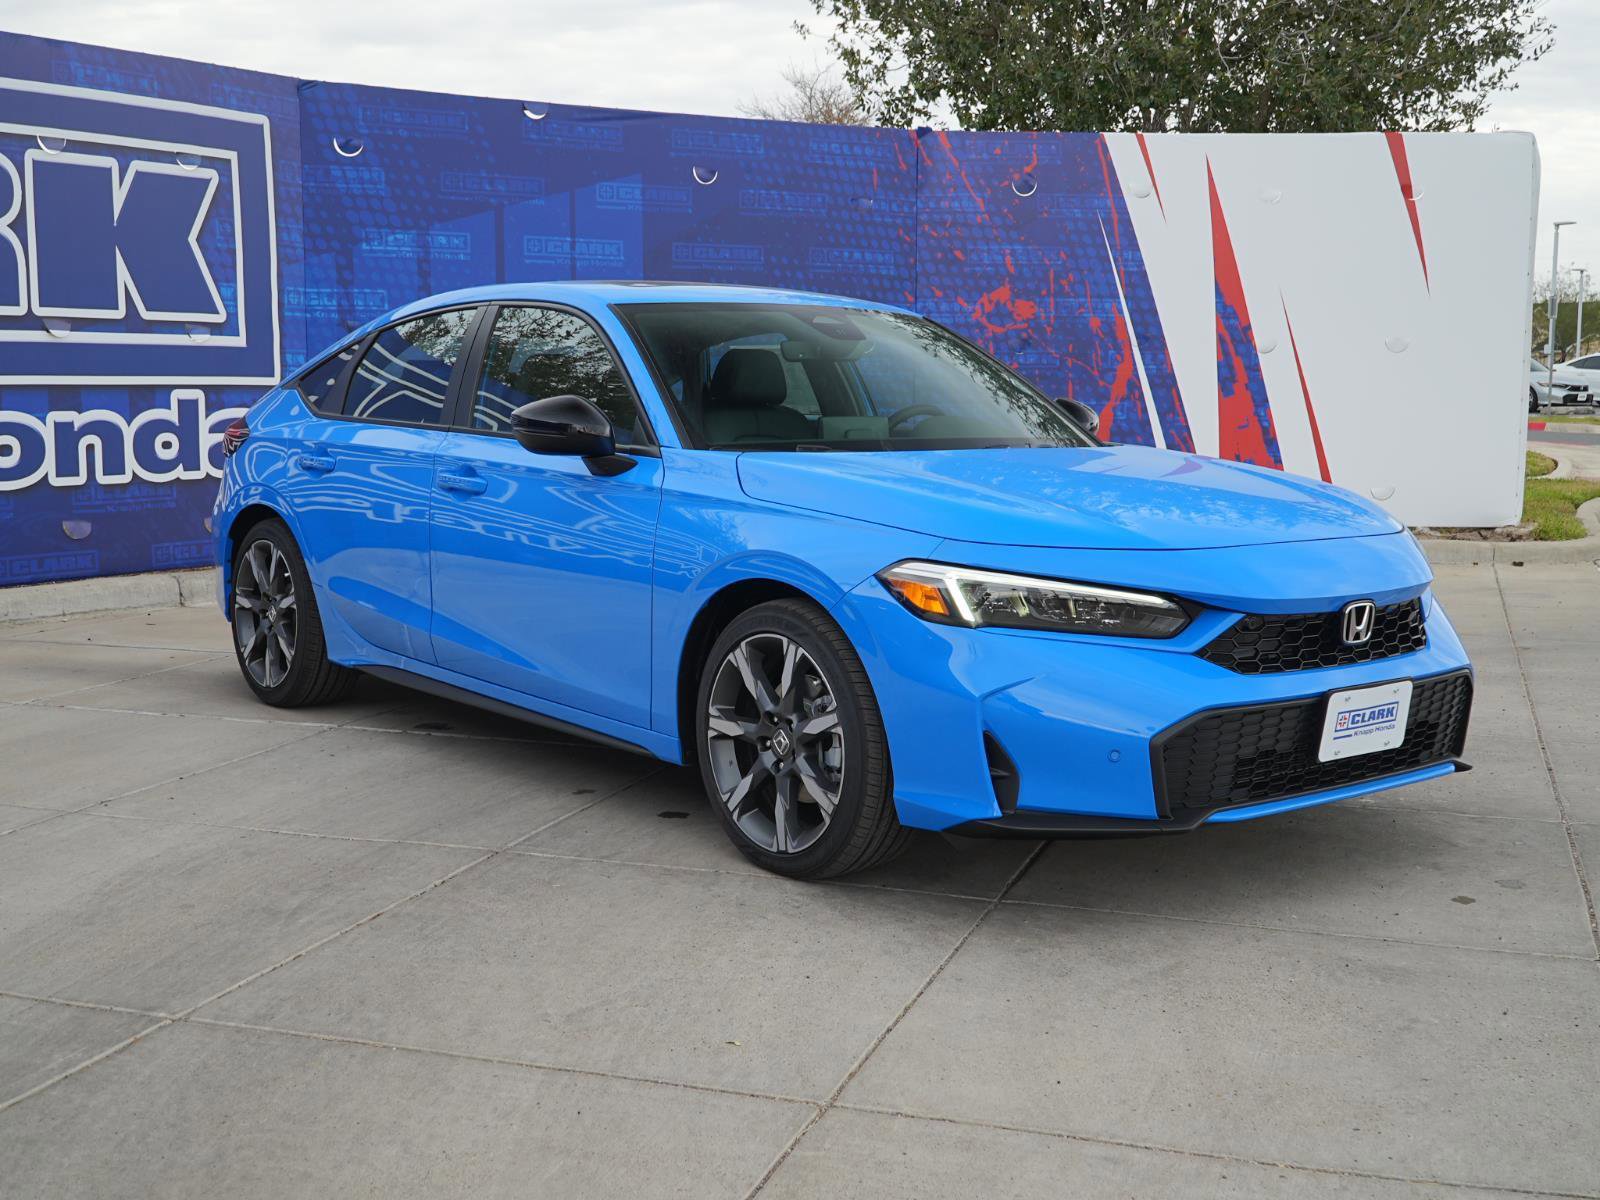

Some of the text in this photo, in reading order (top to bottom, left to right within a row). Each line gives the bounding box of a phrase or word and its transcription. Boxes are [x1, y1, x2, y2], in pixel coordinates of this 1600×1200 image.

[14, 554, 94, 573] CLARK
[1350, 706, 1395, 726] CLARK
[1353, 723, 1396, 737] Knapp Honda
